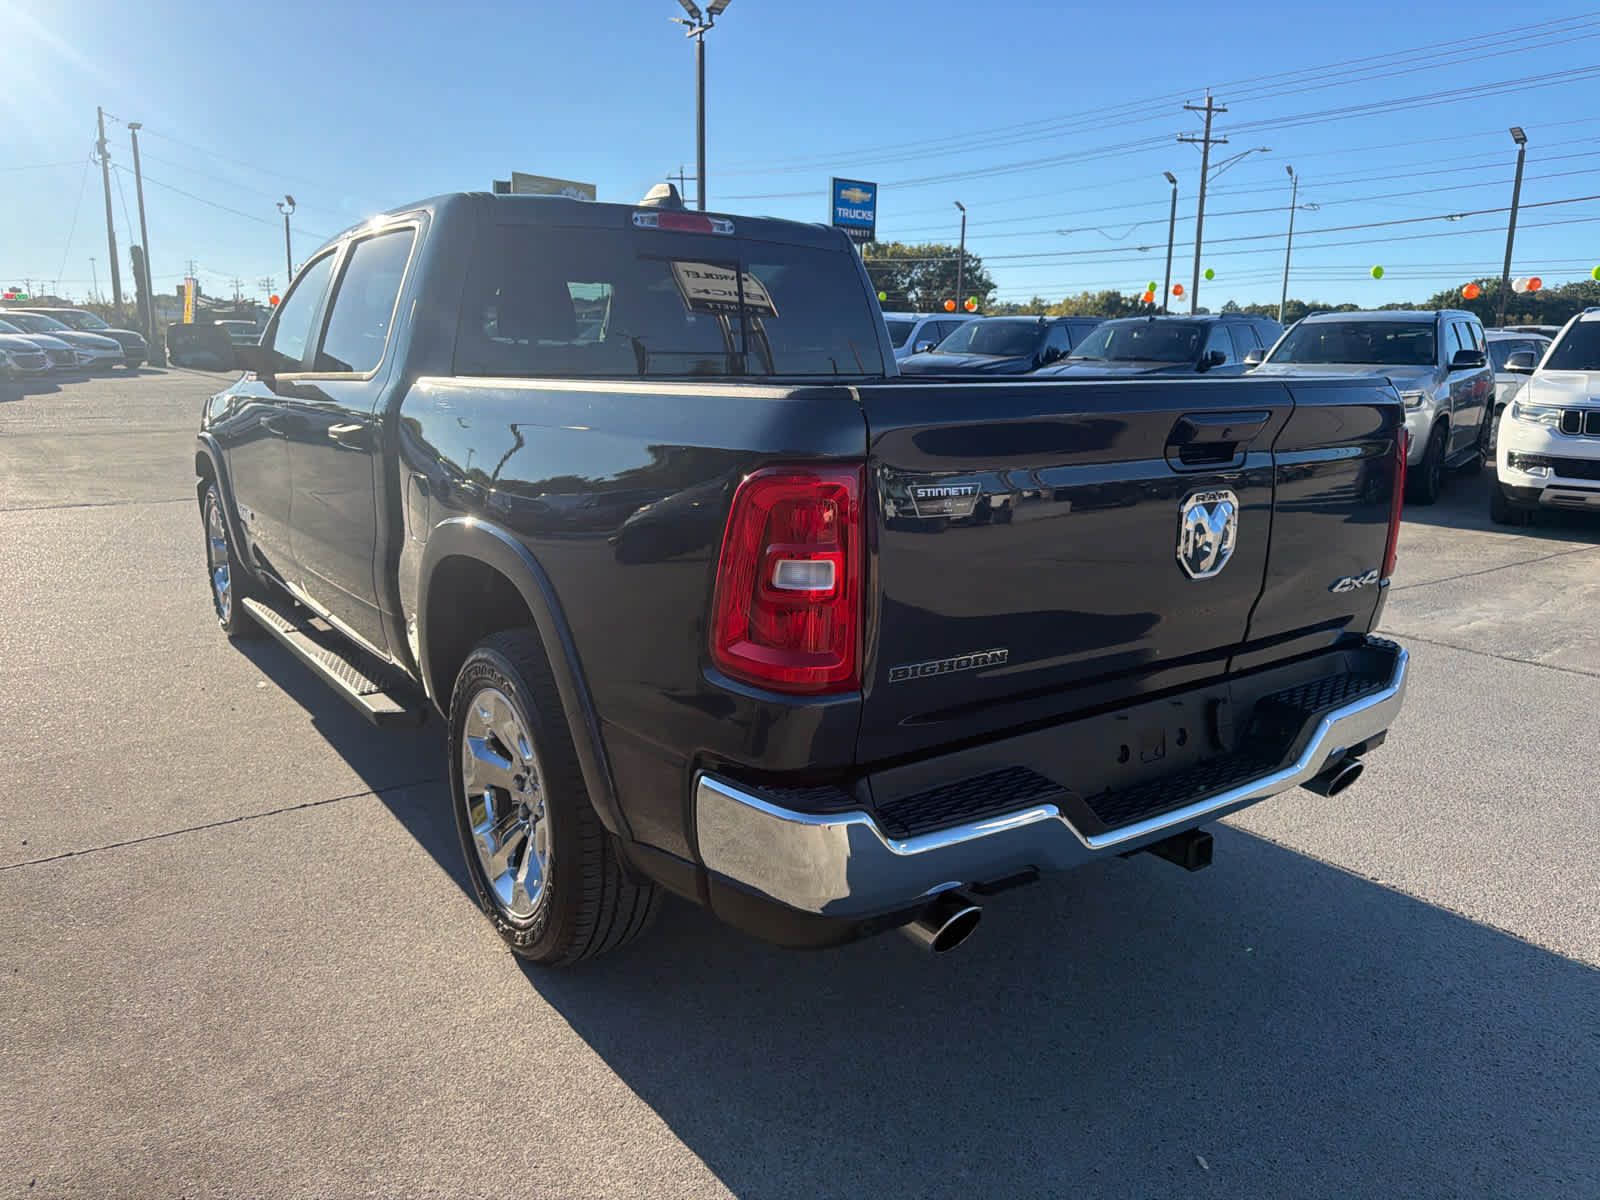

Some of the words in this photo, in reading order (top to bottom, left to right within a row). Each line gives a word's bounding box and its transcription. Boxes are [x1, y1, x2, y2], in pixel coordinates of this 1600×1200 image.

[837, 207, 874, 221] TRUCKS
[917, 486, 973, 497] STINNETT
[1195, 491, 1230, 502] RAM
[888, 649, 1009, 682] BIGHORN
